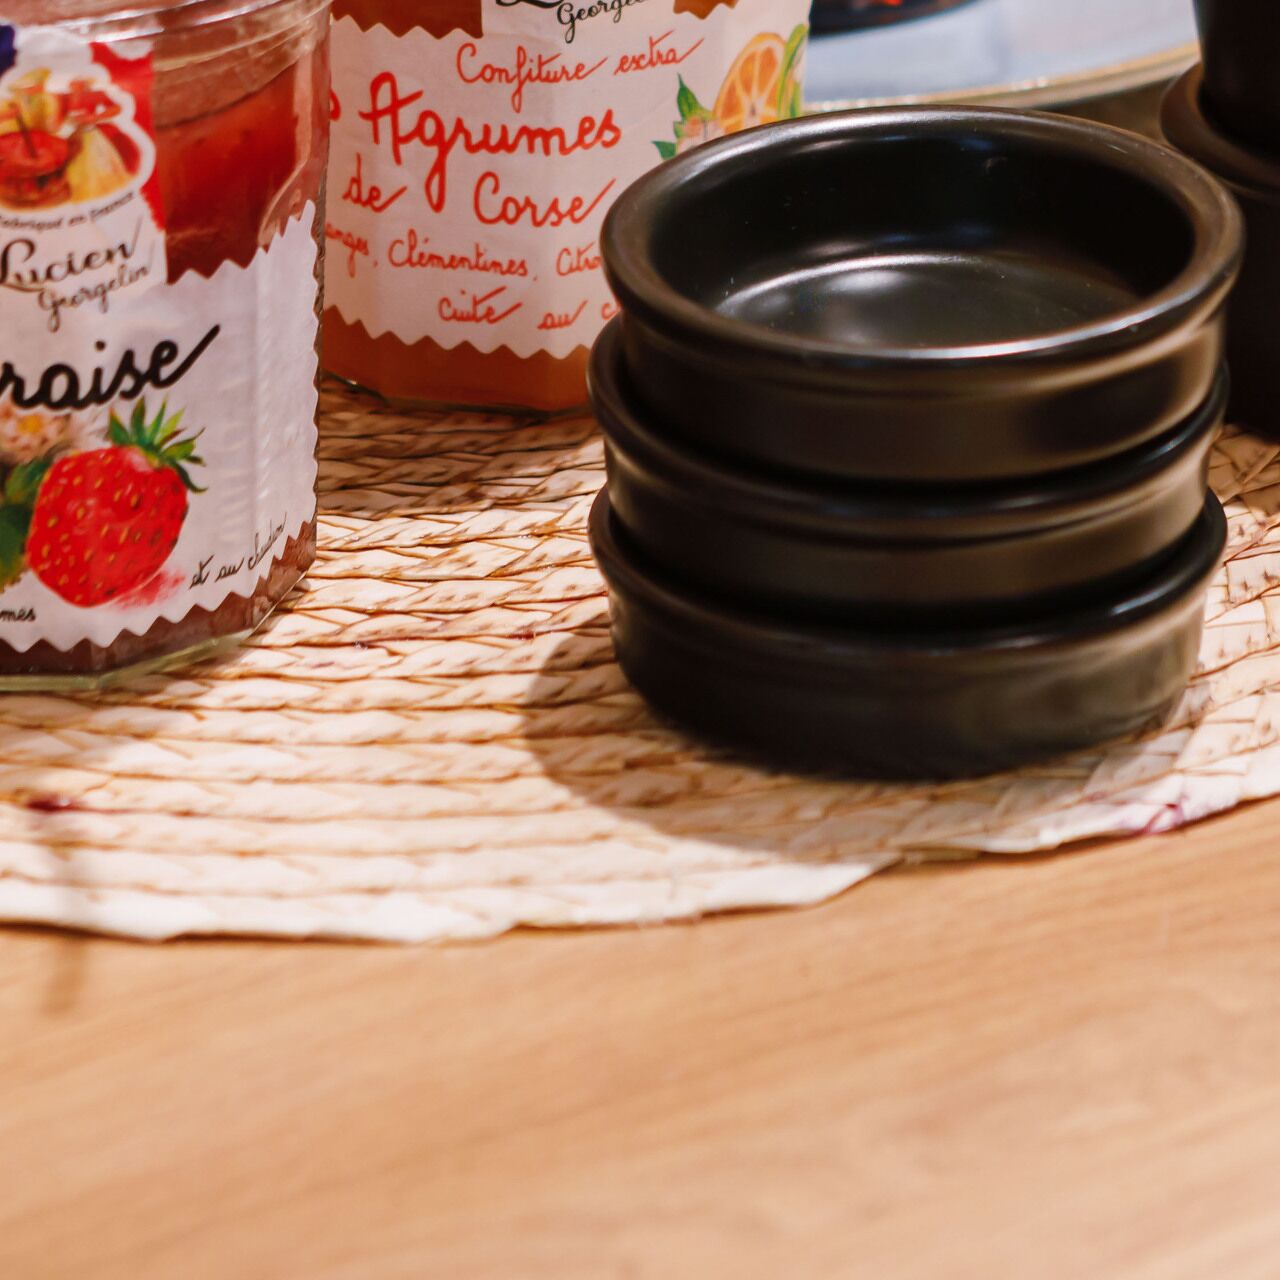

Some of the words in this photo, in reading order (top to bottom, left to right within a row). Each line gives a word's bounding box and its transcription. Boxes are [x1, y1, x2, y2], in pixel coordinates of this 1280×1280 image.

[456, 42, 609, 114] Confiture
[613, 28, 705, 76] extra
[358, 71, 622, 213] Agrumes
[342, 152, 408, 213] de
[473, 171, 617, 228] Corse
[37, 239, 156, 333] Georgelin
[556, 241, 603, 278] Citro
[537, 299, 588, 330] au
[188, 554, 216, 591] et
[214, 557, 246, 583] au
